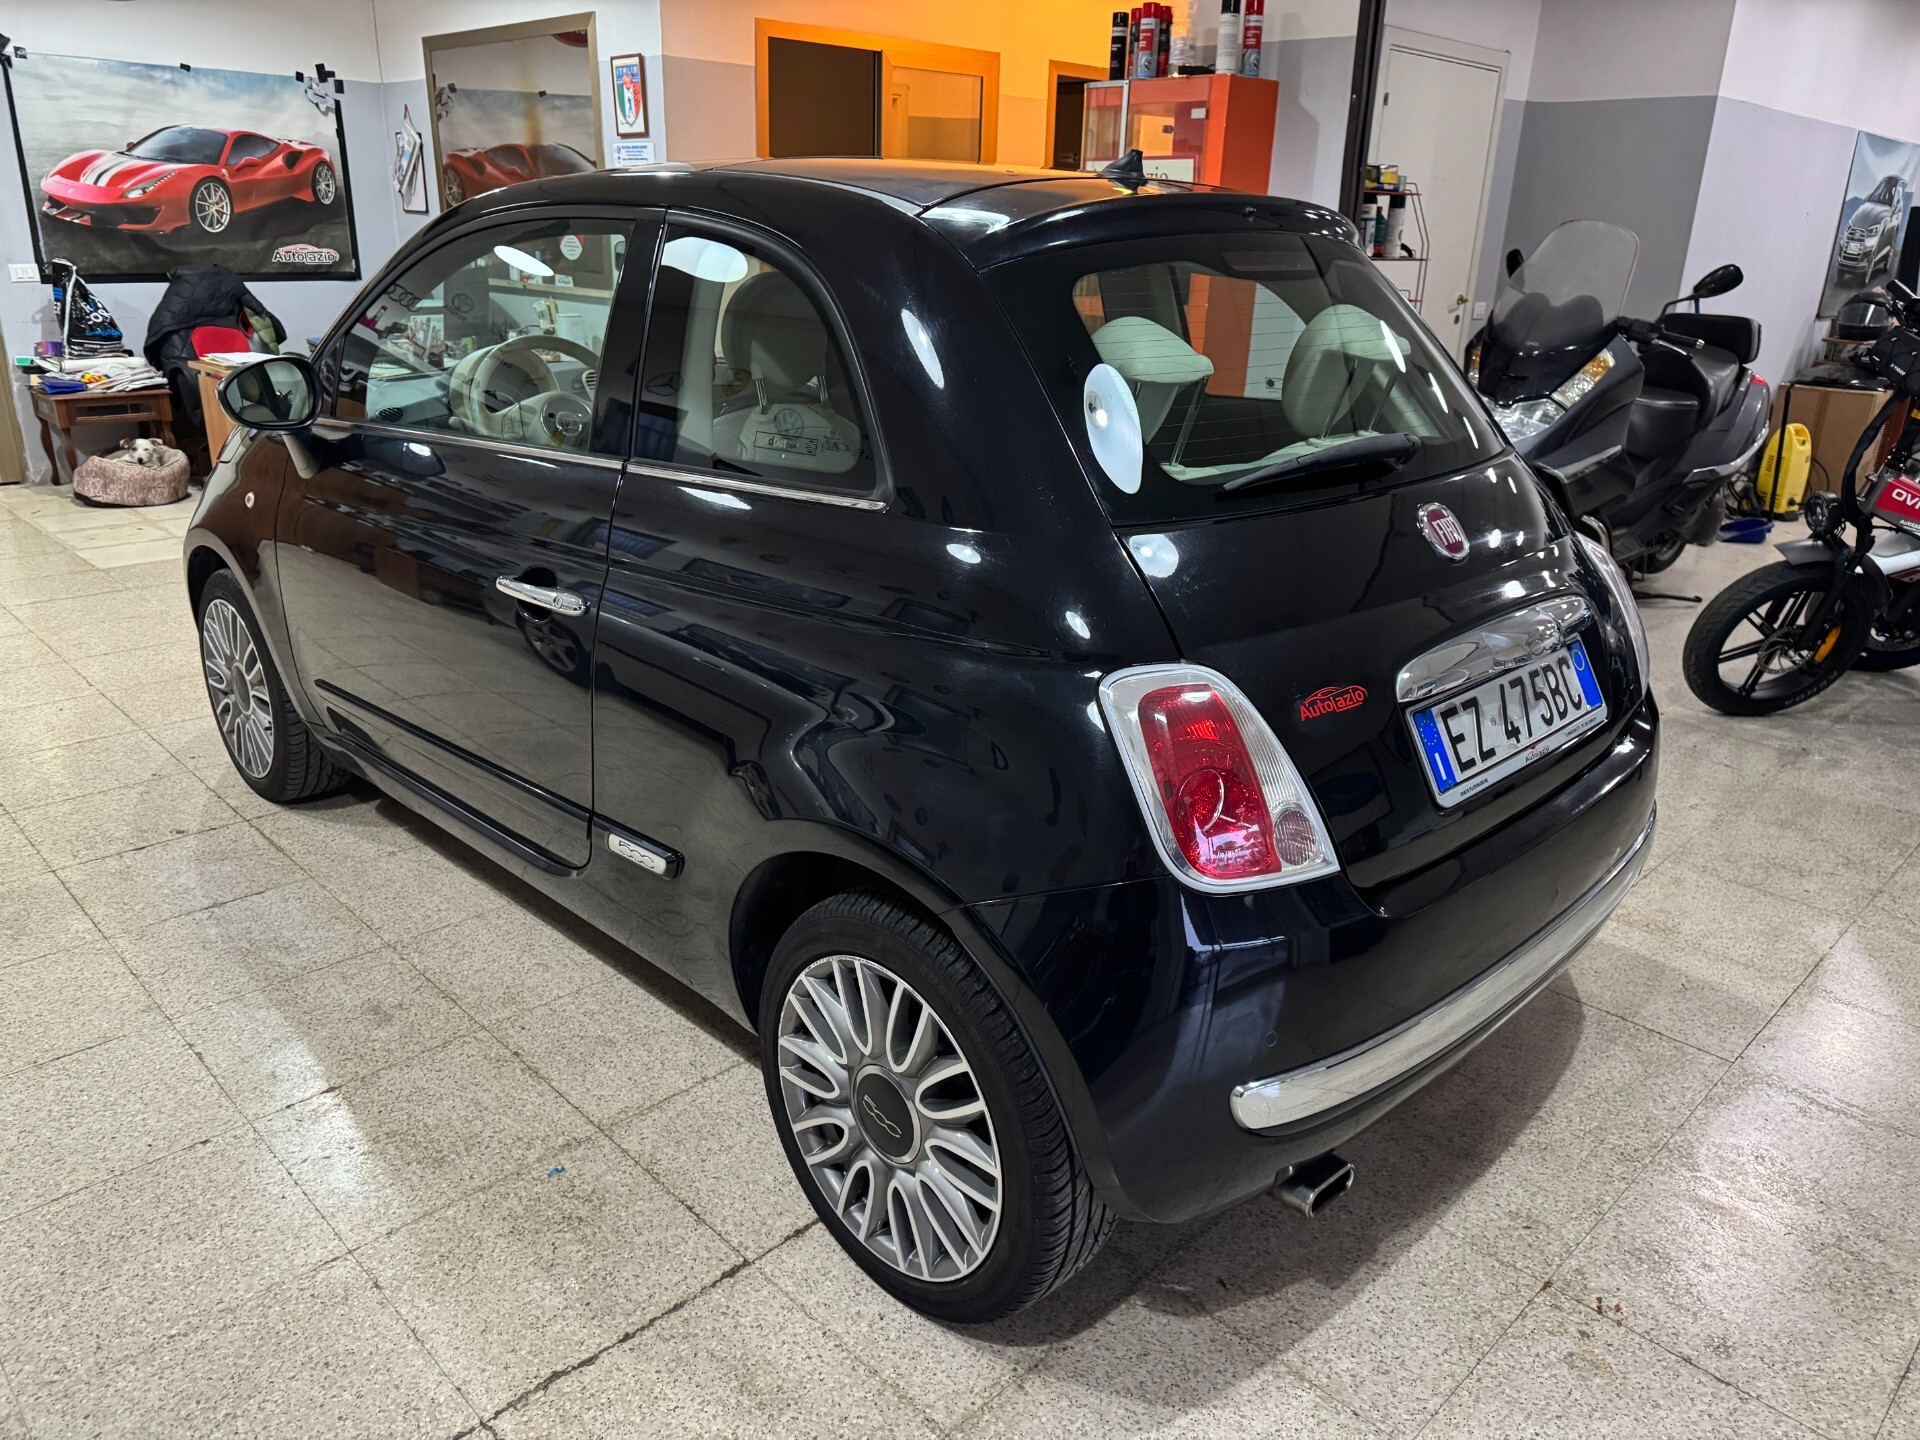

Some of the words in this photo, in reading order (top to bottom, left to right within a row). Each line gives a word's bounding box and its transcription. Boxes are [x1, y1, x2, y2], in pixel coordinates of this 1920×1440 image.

[272, 249, 336, 264] Autolazio
[1431, 516, 1462, 546] FIAT
[1299, 689, 1364, 721] Autolazio
[1440, 697, 1496, 773] EZ
[1500, 655, 1582, 743] 475BC
